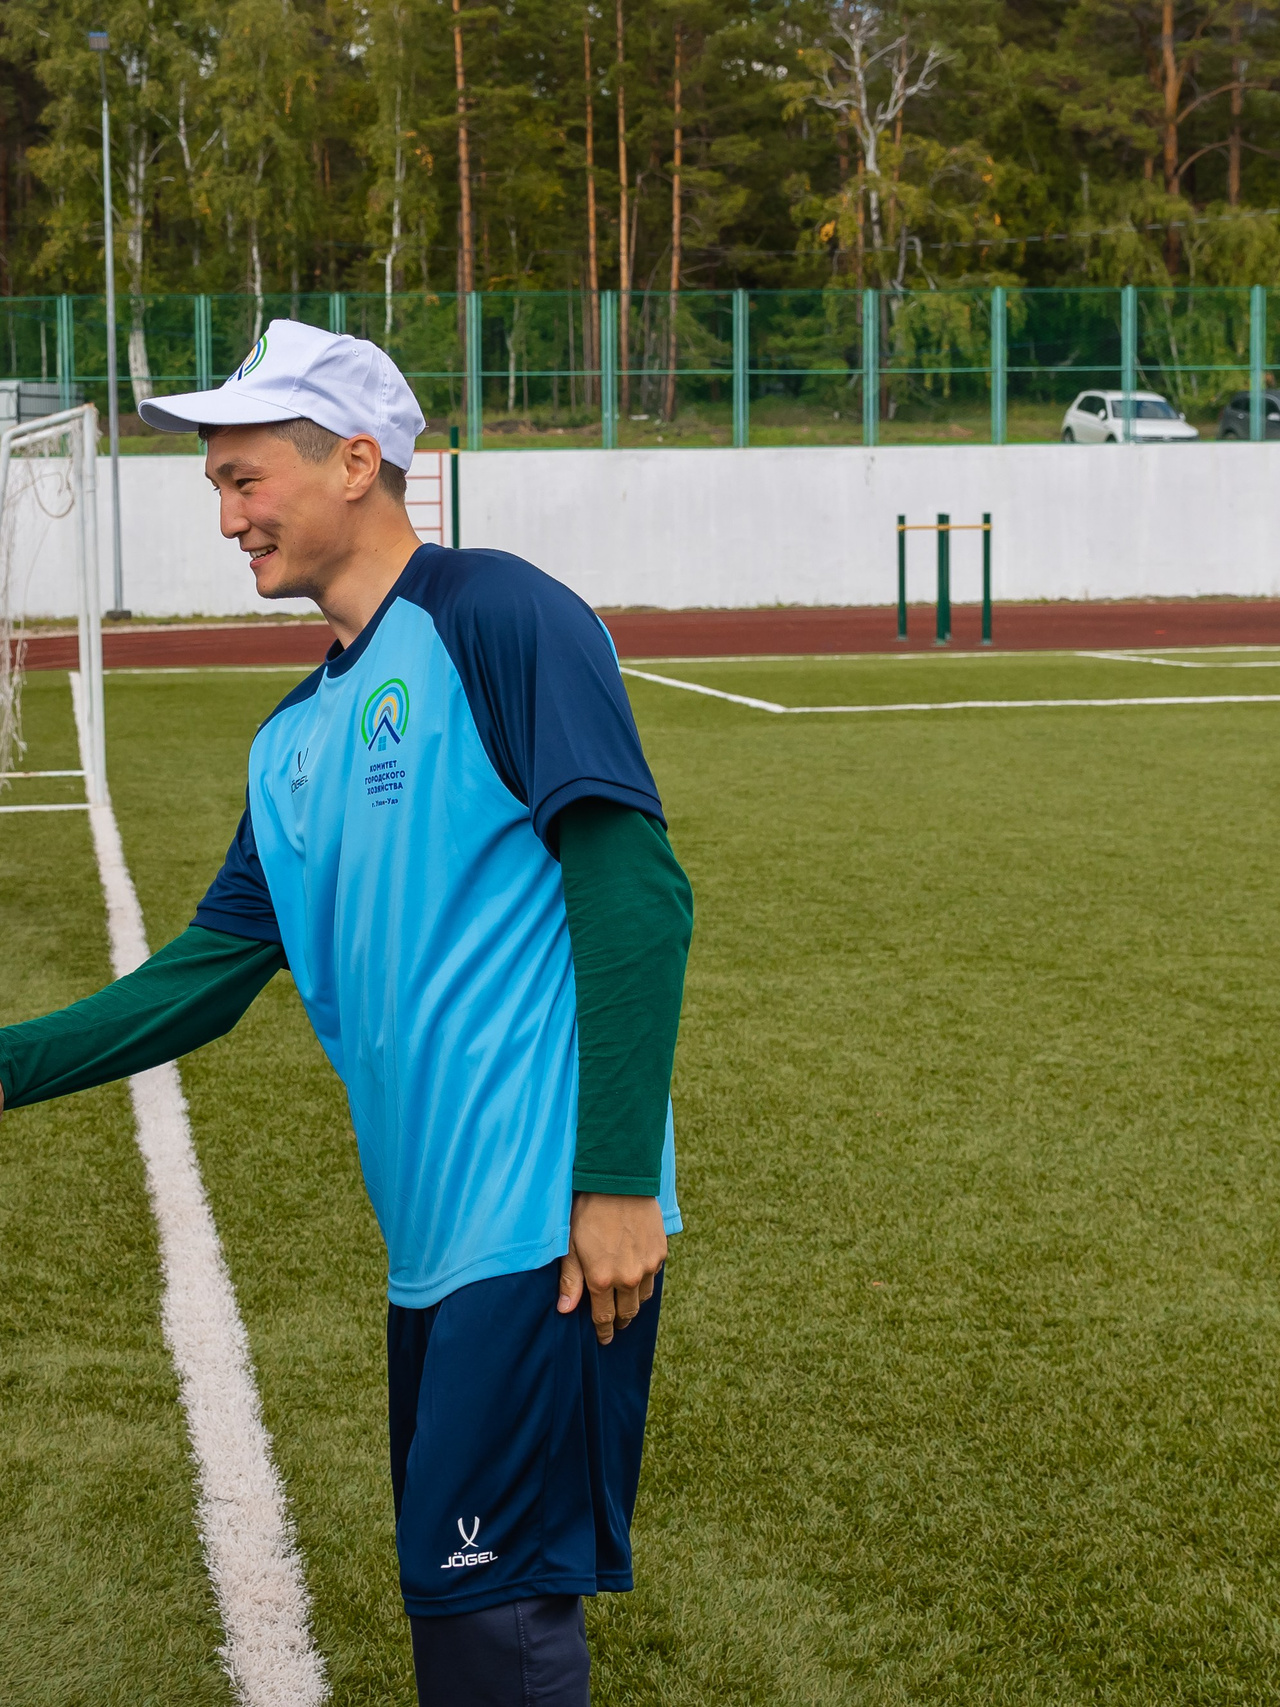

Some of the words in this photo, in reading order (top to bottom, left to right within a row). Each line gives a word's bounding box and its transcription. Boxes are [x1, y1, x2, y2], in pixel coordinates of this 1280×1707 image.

[370, 760, 397, 773] КОМИТЕТ
[291, 775, 309, 793] ÖGEL
[365, 770, 406, 785] ГОРОДСКОГО
[367, 782, 404, 795] ХОЗЯЙСТВА
[440, 1551, 499, 1569] JÖGEL
